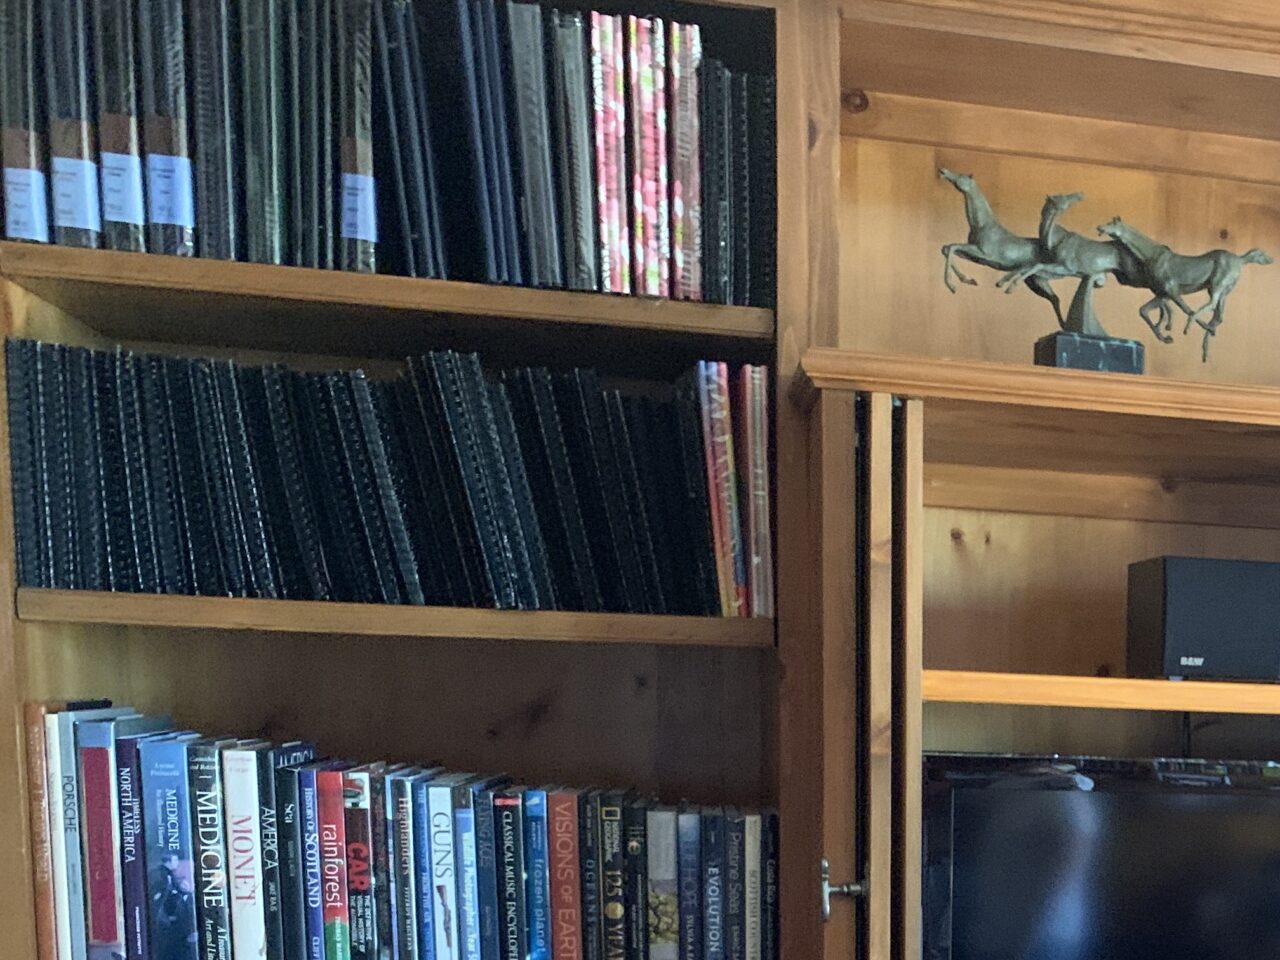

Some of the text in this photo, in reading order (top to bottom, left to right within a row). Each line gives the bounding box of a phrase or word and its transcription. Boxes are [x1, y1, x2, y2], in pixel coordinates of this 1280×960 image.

[62, 775, 77, 833] PORSCHE
[119, 767, 136, 863] NORTH AMERICA
[132, 798, 142, 834] TIMELESS
[165, 788, 180, 851] MEDICINE
[285, 803, 295, 824] Sea
[304, 787, 314, 820] HISTORY
[196, 790, 225, 909] MEDICINE
[232, 814, 256, 906] MONET
[261, 806, 278, 870] AMERICA
[398, 797, 409, 875] Highlanders
[432, 811, 453, 879] GUNS
[503, 811, 514, 863] CLASSICAL
[556, 801, 575, 880] VISIONS
[604, 820, 613, 863] GEOGRAPHIC
[612, 820, 620, 853] NATIONAL
[305, 832, 321, 908] SCOTLAND
[322, 823, 344, 908] rainforest
[347, 841, 371, 891] CAR
[505, 865, 516, 898] MUSIC
[534, 859, 545, 905] frozen
[561, 885, 573, 904] OF
[586, 859, 598, 922] OCEANS
[606, 869, 622, 897] 125
[681, 867, 698, 908] HOPE
[729, 832, 742, 914] Pristine Seas
[463, 867, 475, 926] Photographer
[708, 866, 720, 953] EVOLUTION
[534, 908, 547, 953] planet
